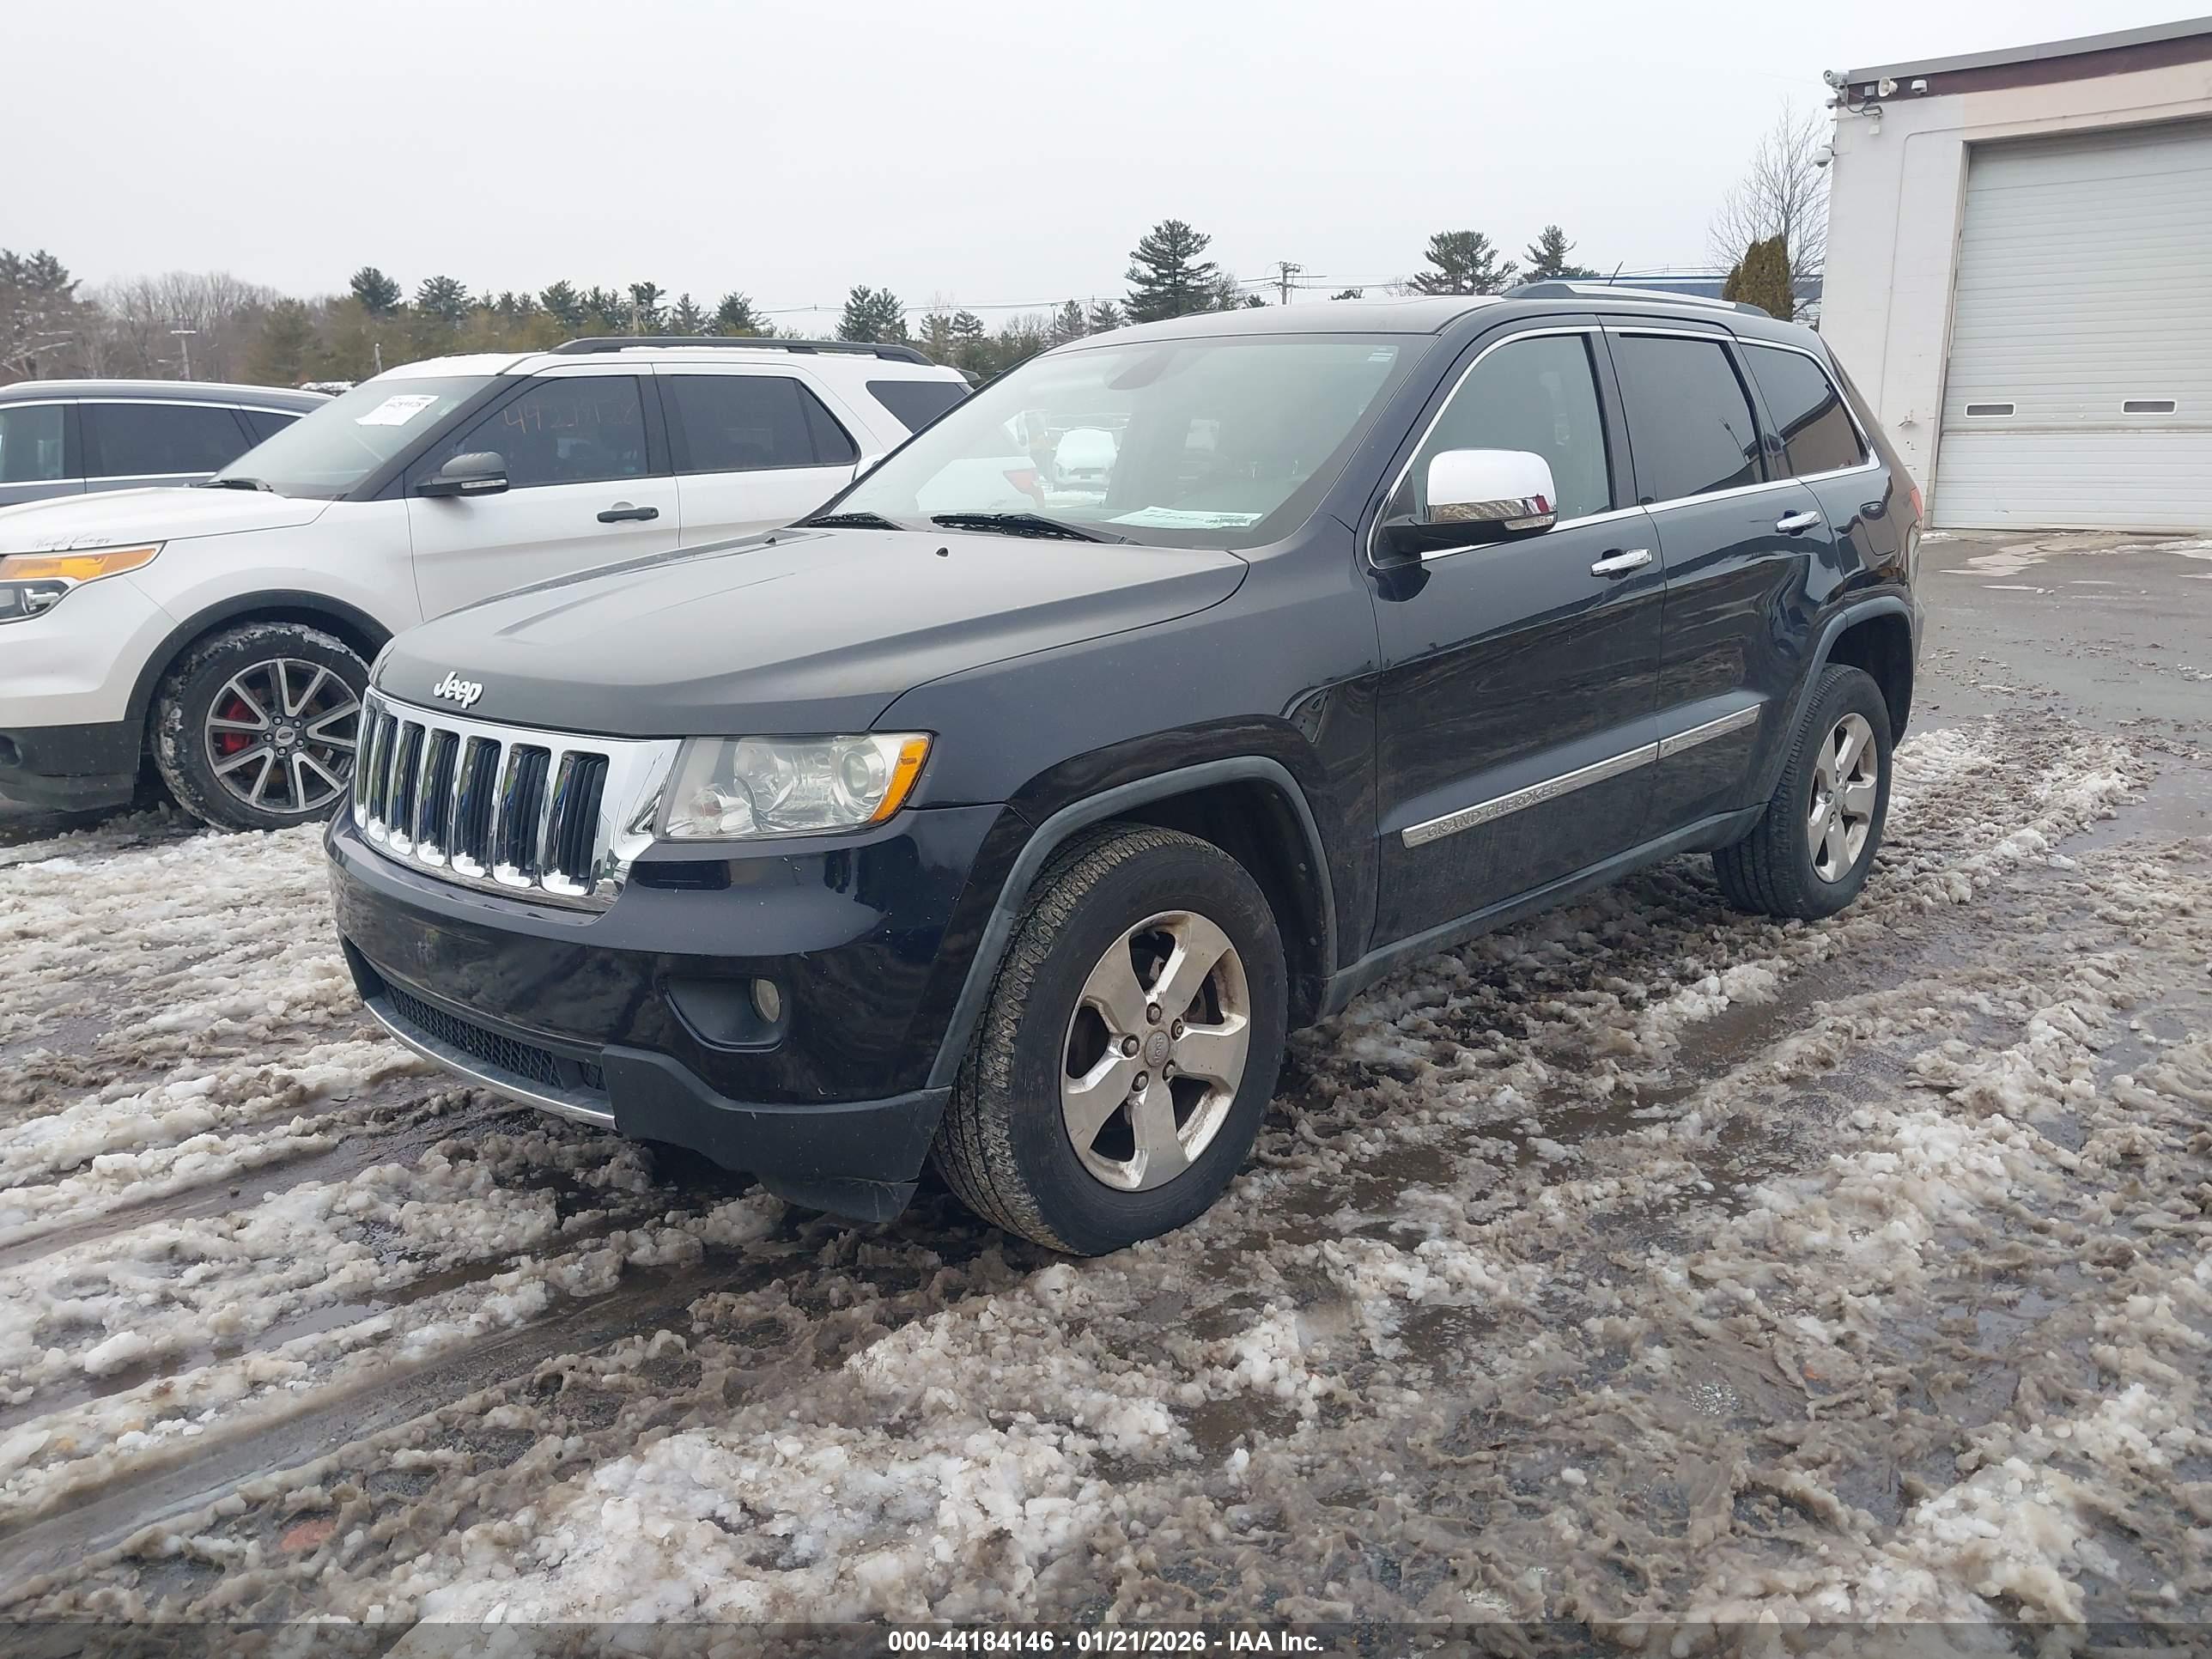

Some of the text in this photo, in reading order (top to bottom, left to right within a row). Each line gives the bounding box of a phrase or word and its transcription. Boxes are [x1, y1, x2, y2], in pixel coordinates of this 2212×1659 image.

[433, 671, 484, 709] Jeep
[1426, 782, 1562, 839] GRAND CHEROKEE
